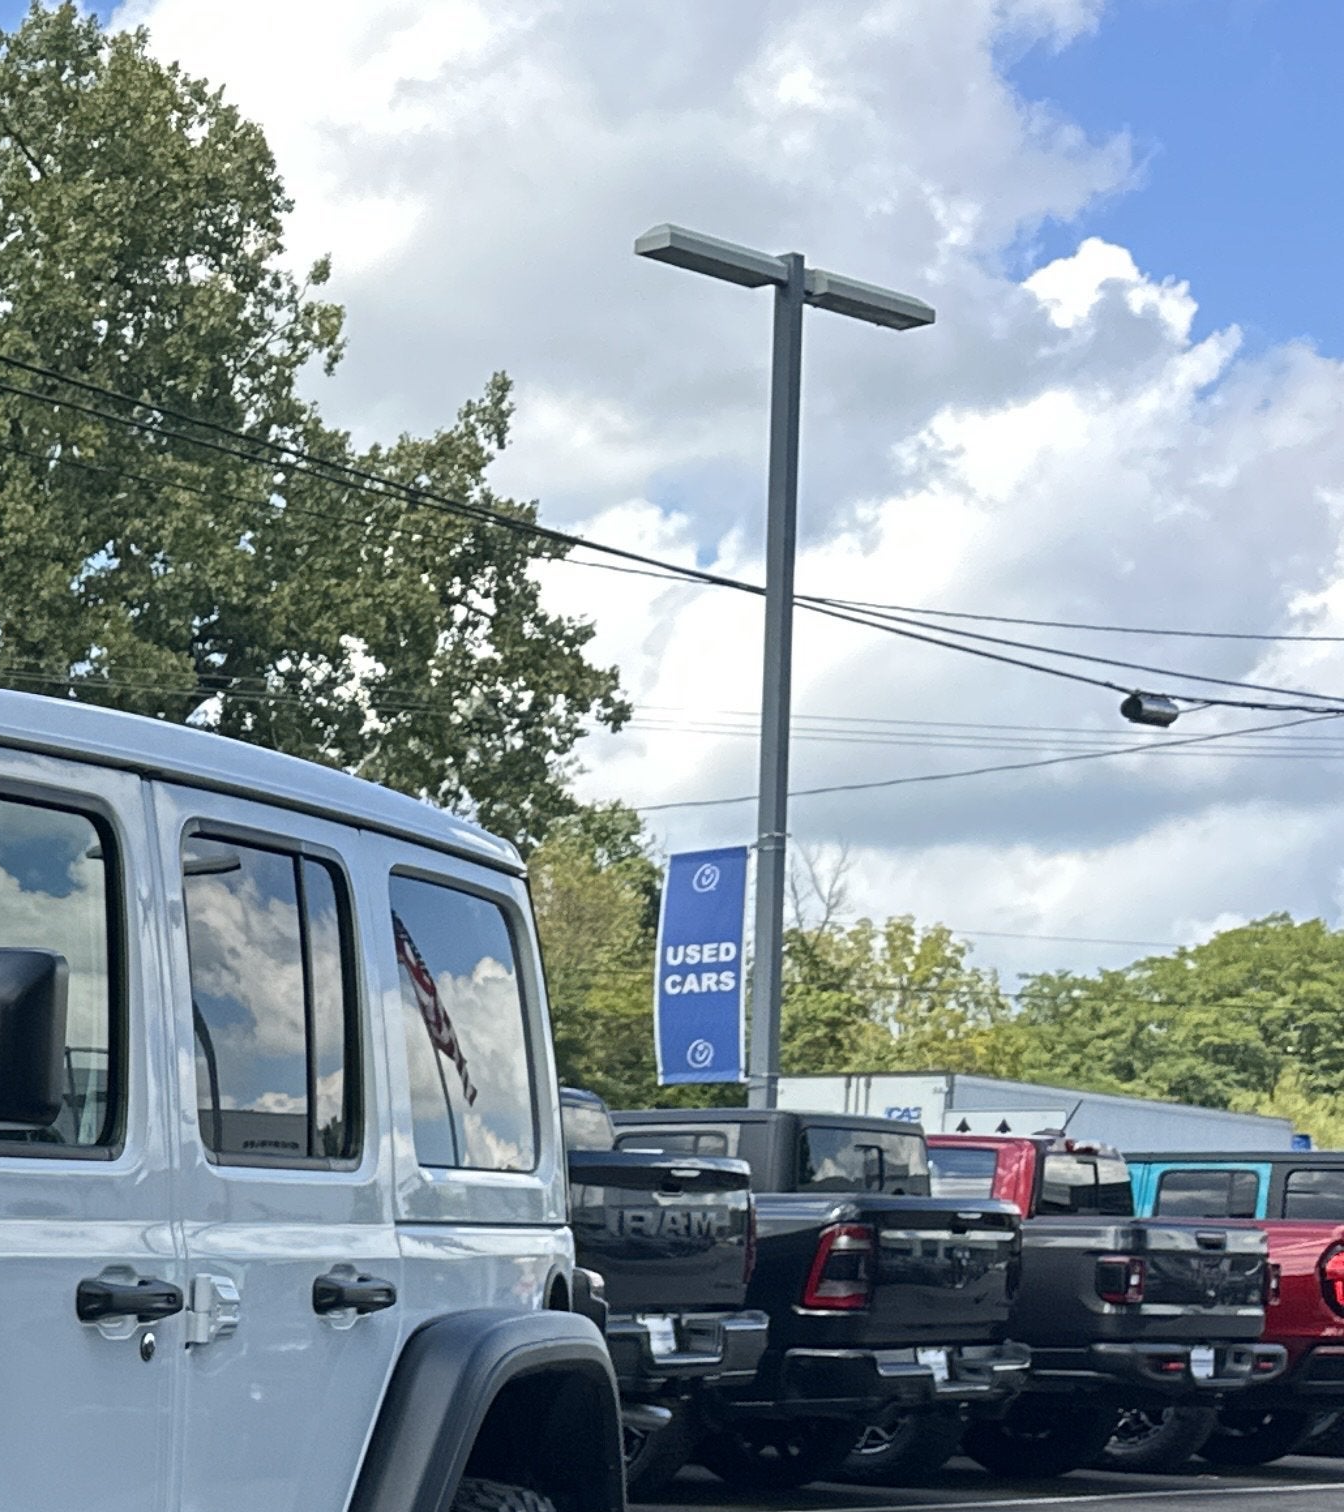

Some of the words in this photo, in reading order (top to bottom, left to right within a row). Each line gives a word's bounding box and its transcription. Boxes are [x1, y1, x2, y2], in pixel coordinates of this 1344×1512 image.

[666, 941, 737, 966] USED
[664, 971, 736, 996] CARS
[621, 1209, 717, 1238] RAM
